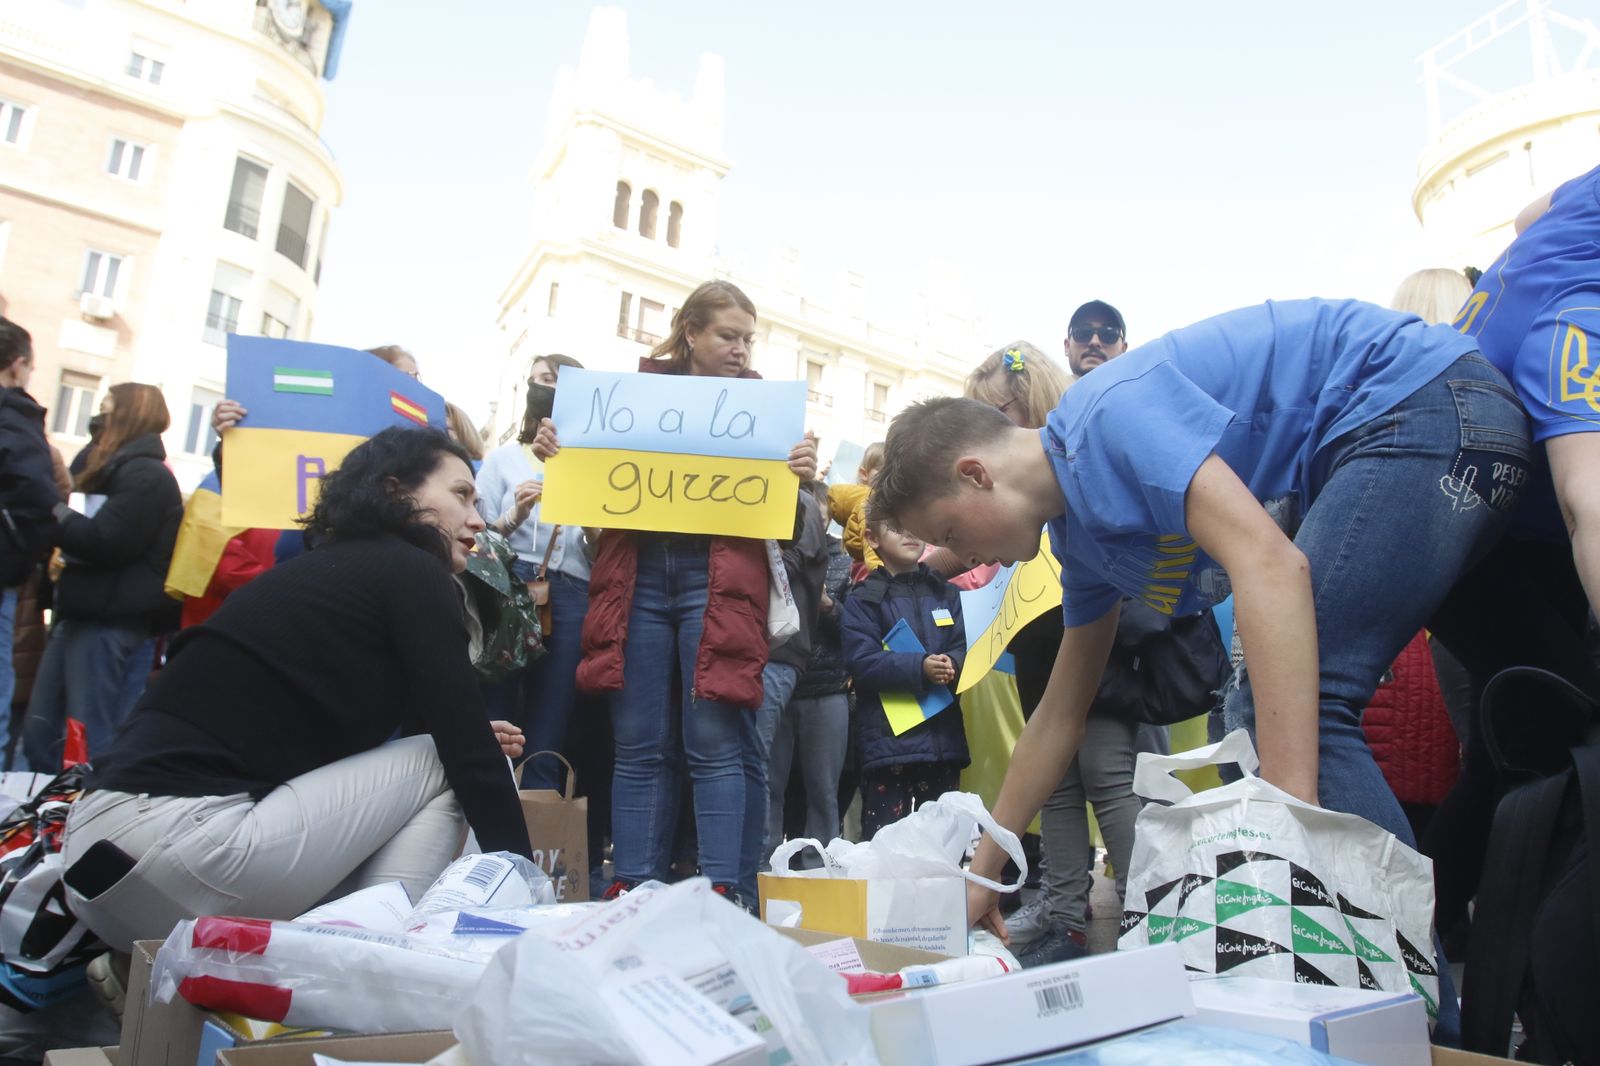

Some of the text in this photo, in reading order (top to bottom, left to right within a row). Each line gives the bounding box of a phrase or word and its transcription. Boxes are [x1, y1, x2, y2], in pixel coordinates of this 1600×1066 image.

[583, 379, 756, 439] No a la
